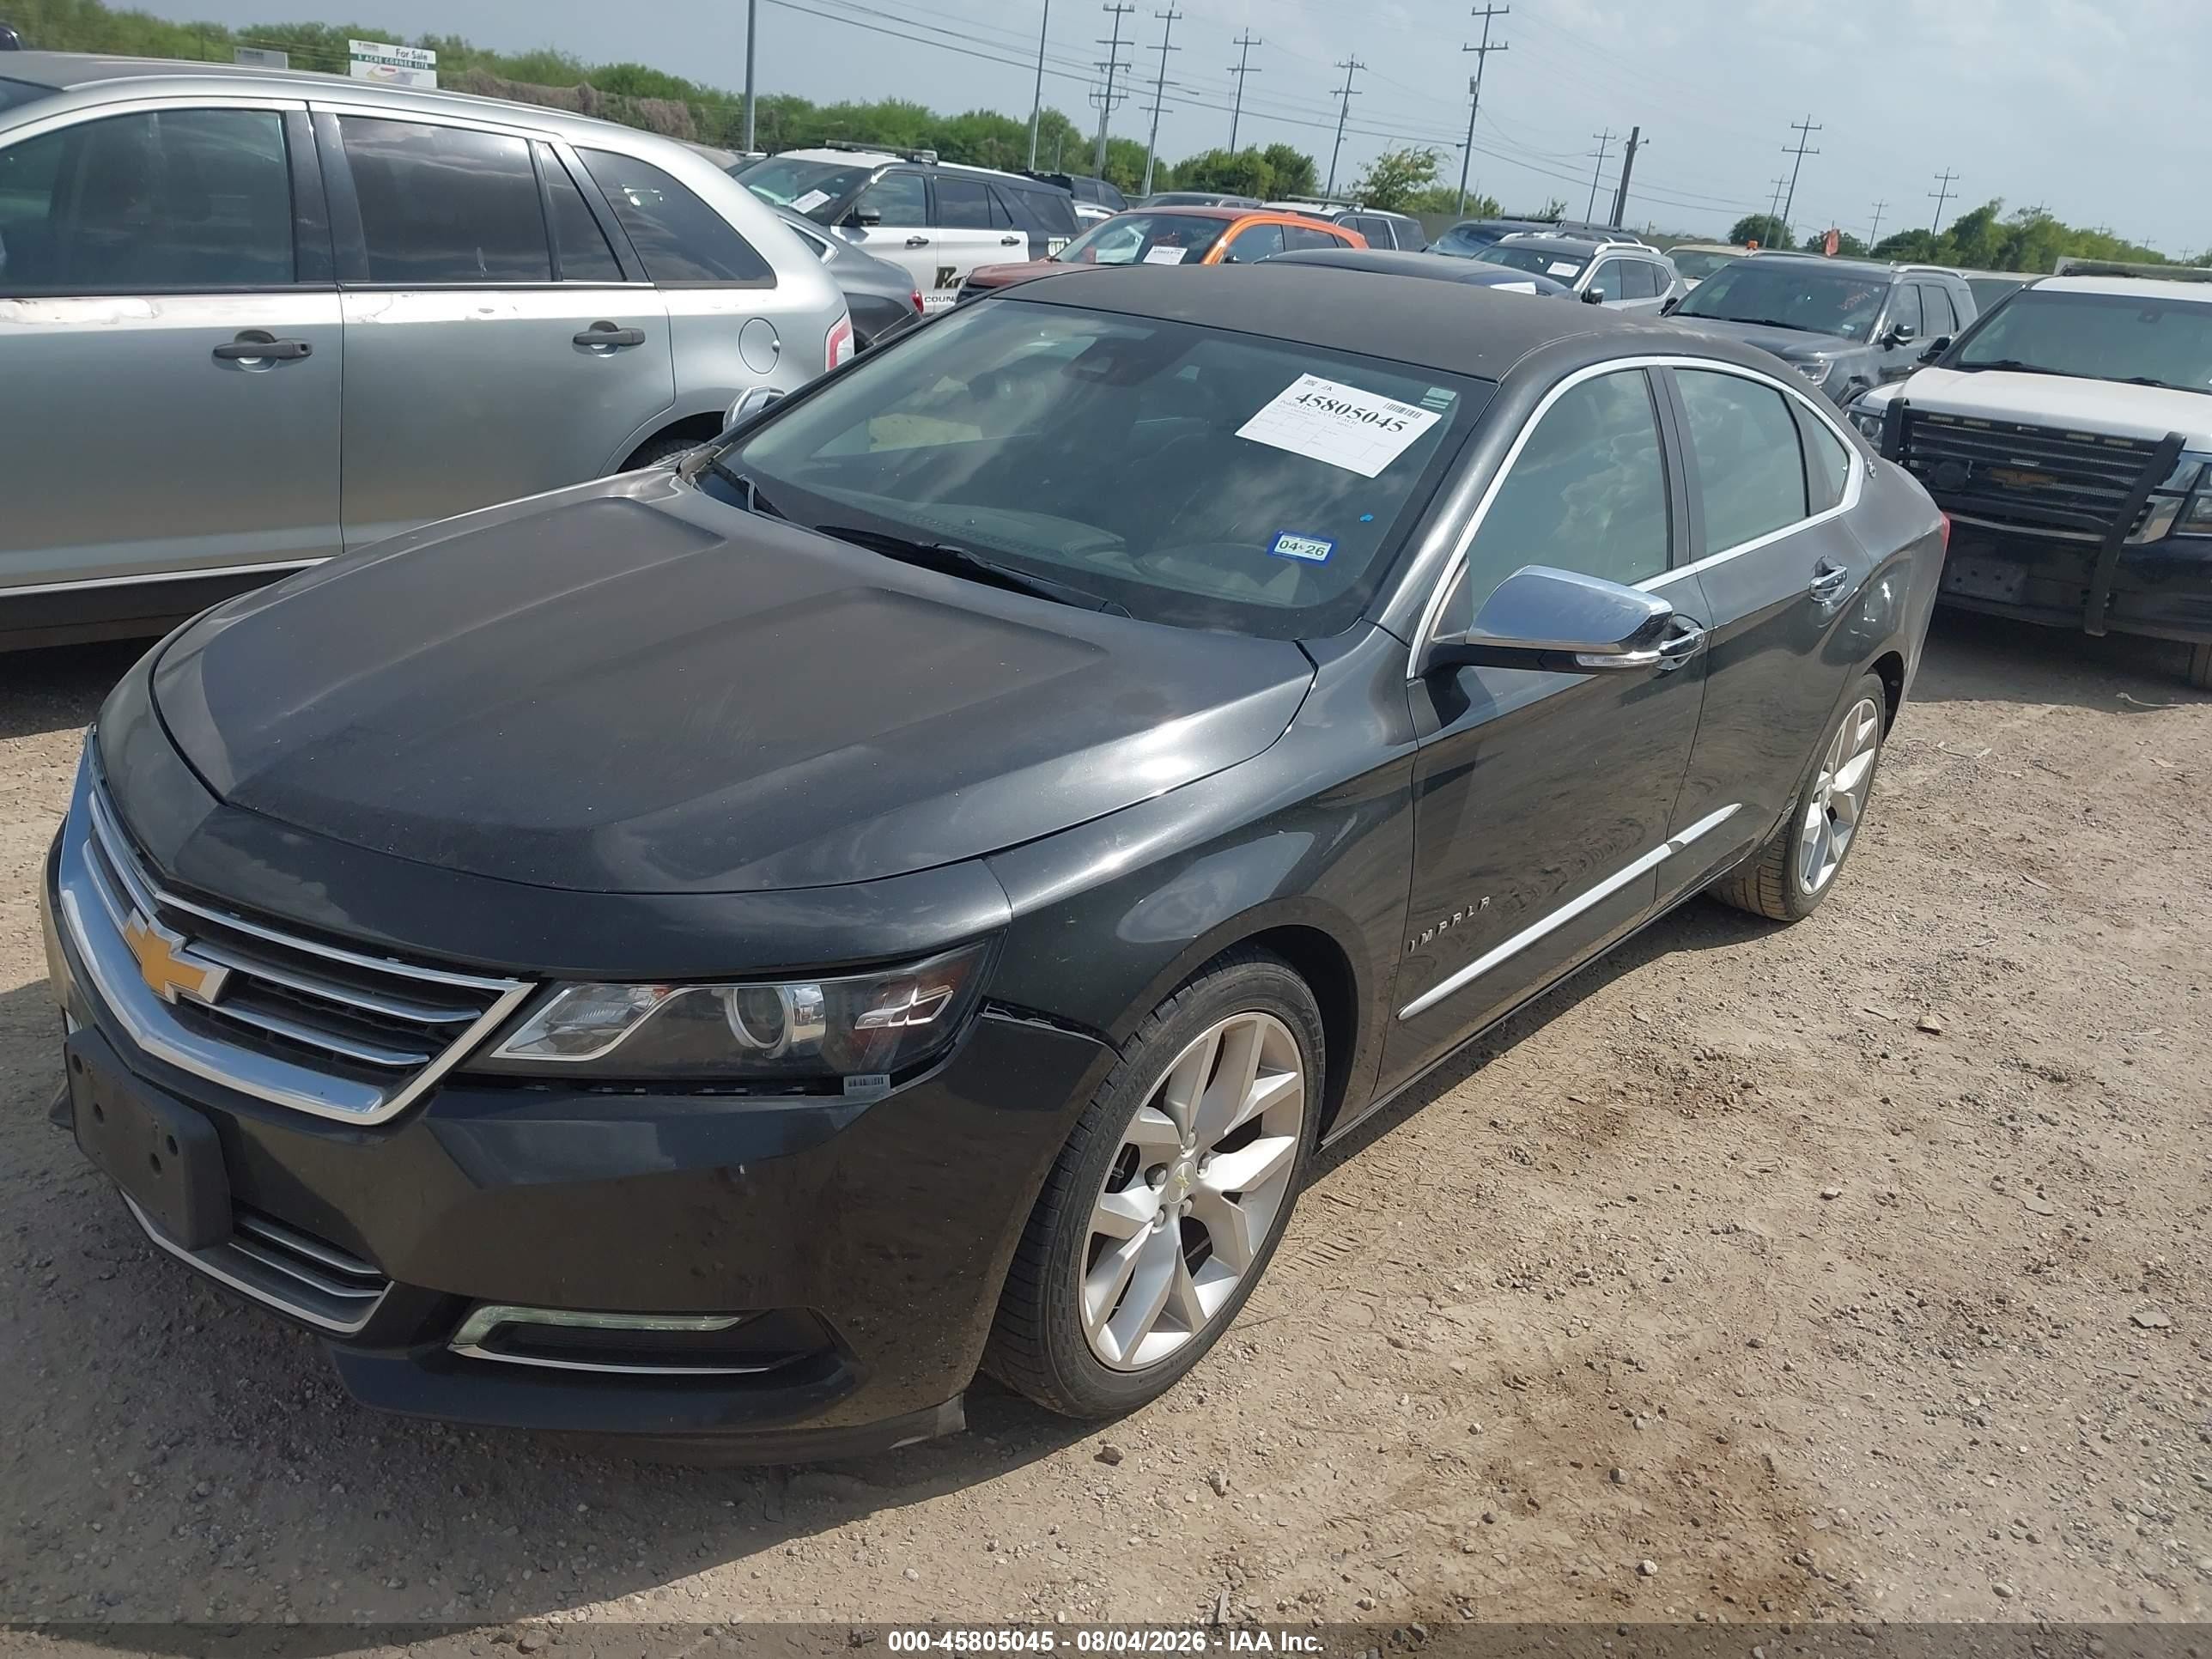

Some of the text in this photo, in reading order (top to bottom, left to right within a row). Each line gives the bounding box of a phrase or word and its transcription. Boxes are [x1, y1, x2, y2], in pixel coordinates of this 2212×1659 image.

[395, 47, 428, 61] For Sale
[1295, 392, 1409, 433] 45805045
[1279, 540, 1326, 556] 04 26
[1408, 896, 1491, 953] IMPALA
